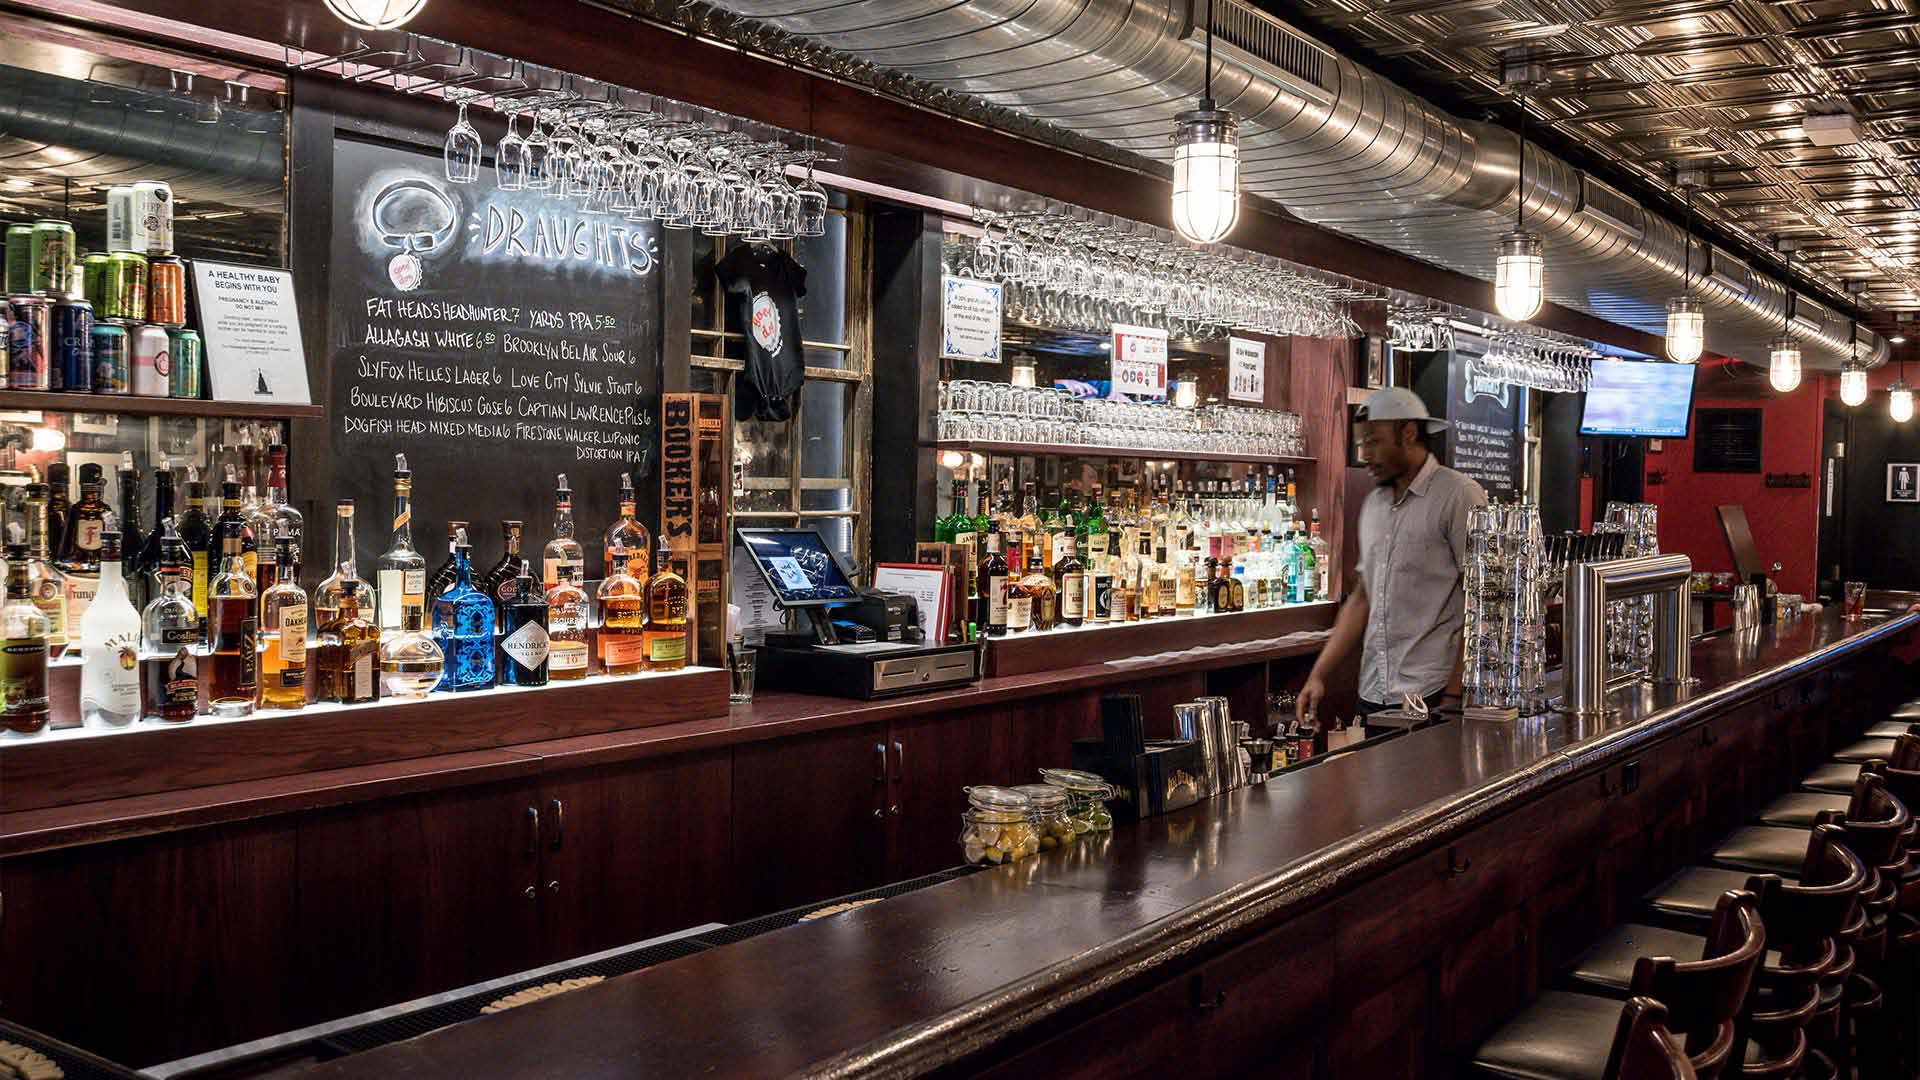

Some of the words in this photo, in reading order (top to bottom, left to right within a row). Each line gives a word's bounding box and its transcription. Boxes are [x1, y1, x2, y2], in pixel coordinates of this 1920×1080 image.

[482, 203, 653, 276] DRAUGHTS
[208, 270, 215, 278] A
[216, 271, 256, 282] HEALTHY
[257, 274, 281, 284] BABY
[215, 280, 242, 290] BEGINS
[244, 283, 261, 292] WITH
[262, 284, 278, 293] YOU
[366, 298, 393, 318] FAT
[397, 300, 441, 319] HEAD'S
[443, 302, 513, 322] HEADHUNTER
[512, 308, 520, 323] 7
[530, 310, 564, 328] YARDS
[568, 312, 594, 331] PPA
[365, 324, 430, 347] ALLAGASH
[434, 330, 474, 348] WHITE
[503, 333, 559, 360] BROOKLYN
[560, 340, 581, 360] BEL
[583, 344, 598, 362] AIR
[602, 343, 626, 364] SOUR
[628, 350, 636, 364] 6
[408, 360, 453, 382] HELLES
[455, 366, 490, 385] LAGER
[492, 367, 502, 384] 6
[511, 367, 541, 388] LOVE
[545, 371, 569, 392] CITY
[574, 372, 604, 394] SYLVIE
[607, 376, 633, 395] STOUT
[634, 381, 642, 395] 6
[426, 392, 473, 413] HIBISCUS
[477, 395, 503, 415] GOSE
[504, 399, 512, 415] 6
[518, 396, 567, 419] CAPTIAN
[571, 401, 625, 425] LAWRENCE
[624, 406, 643, 425] PILS
[643, 409, 651, 425] 6
[344, 415, 392, 433] DOGFISH
[396, 419, 426, 434] HEAD
[429, 420, 465, 436] MIXED
[467, 423, 502, 438] MEDIA
[502, 423, 511, 438] 6
[516, 422, 562, 441] FIRESTONE
[565, 427, 601, 443] WALKER
[603, 432, 640, 445] LUPONIC
[576, 446, 622, 460] DISTORTION
[626, 449, 640, 463] IPA
[641, 449, 648, 463] 7
[665, 400, 693, 538] BOOKER'S
[273, 528, 301, 536] PMA
[68, 584, 97, 602] Frang
